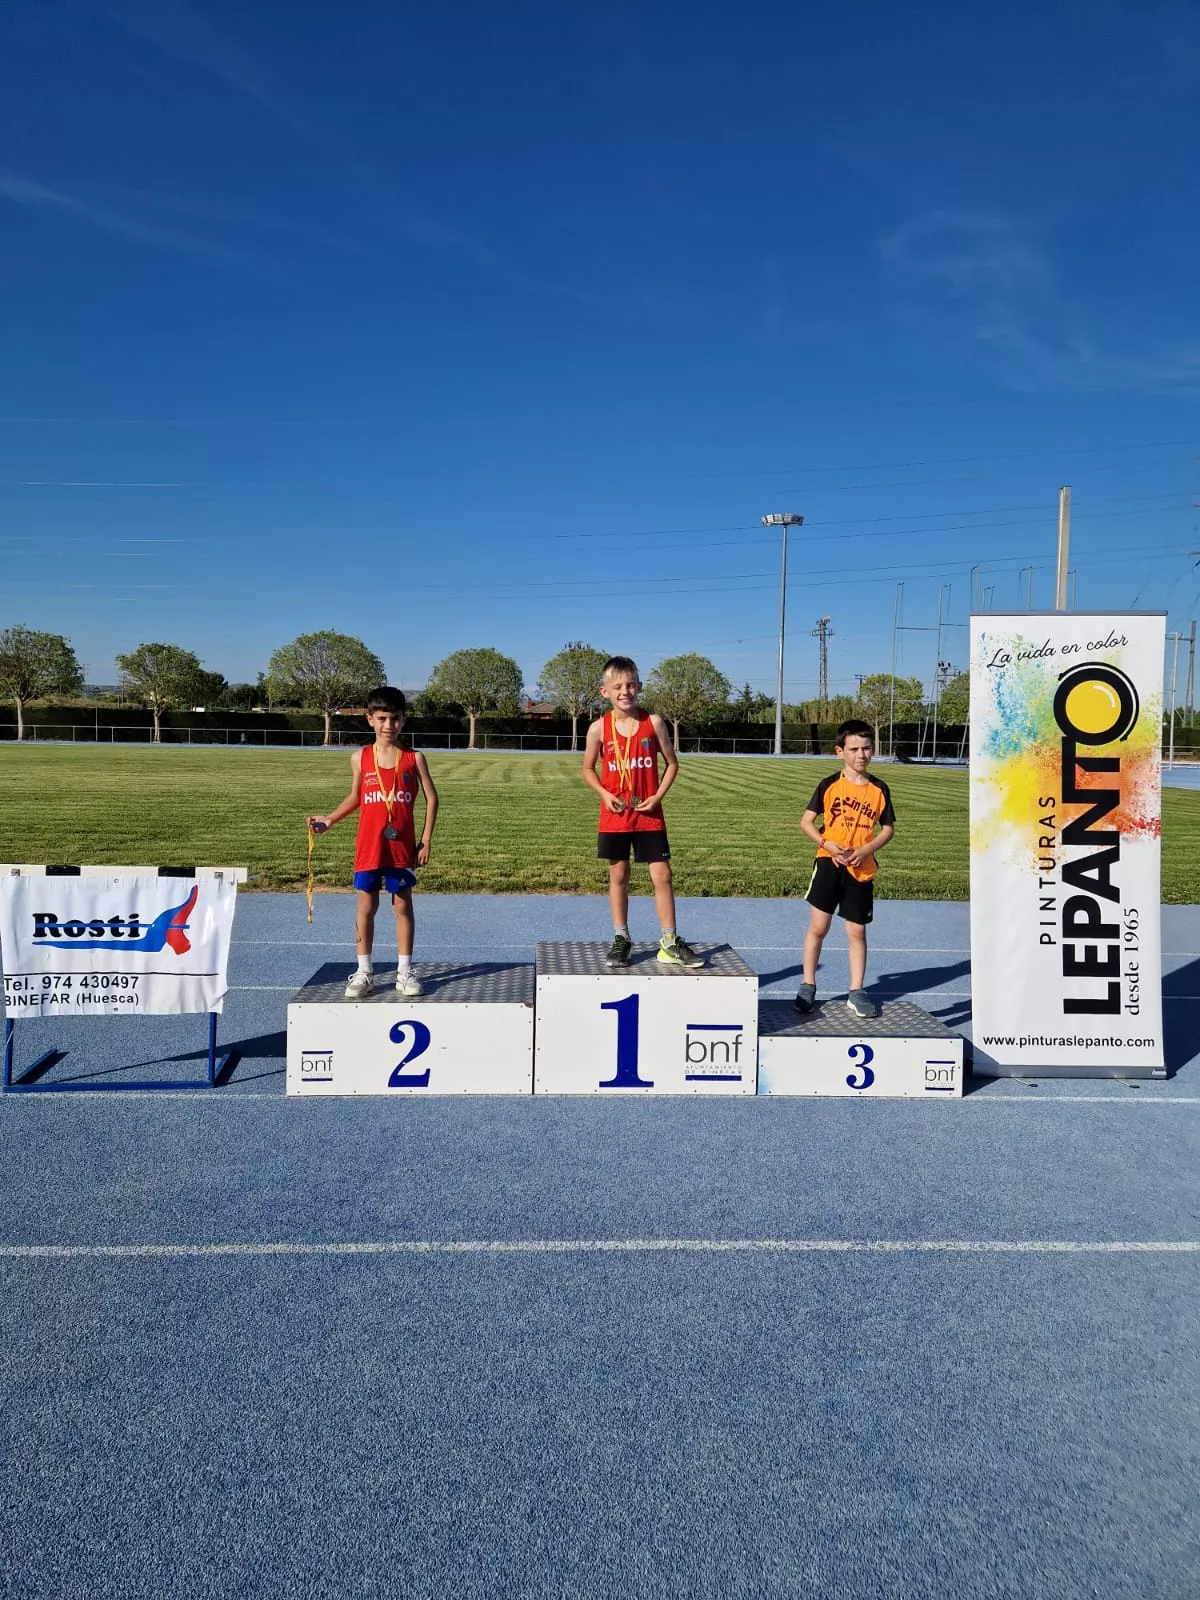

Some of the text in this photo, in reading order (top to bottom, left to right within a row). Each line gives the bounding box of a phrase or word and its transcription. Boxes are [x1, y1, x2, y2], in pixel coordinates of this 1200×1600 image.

[986, 630, 1129, 668] La vida en color
[607, 756, 653, 772] HIACO
[1053, 667, 1133, 1015] LEPANTO
[1038, 796, 1057, 945] PINTURAS
[32, 913, 141, 938] Rosti
[1123, 908, 1140, 1016] desde 1965
[4, 975, 139, 991] Tel. 974 430497
[4, 992, 139, 1006] BINEFAR (Huesca)
[388, 1019, 431, 1088] 2
[599, 993, 654, 1088] 1
[685, 1033, 743, 1063] bnf
[983, 1035, 1155, 1048] www.pinturaslepanto.com
[301, 1055, 333, 1072] bnf
[846, 1044, 875, 1090] 3
[925, 1065, 955, 1081] bnf
